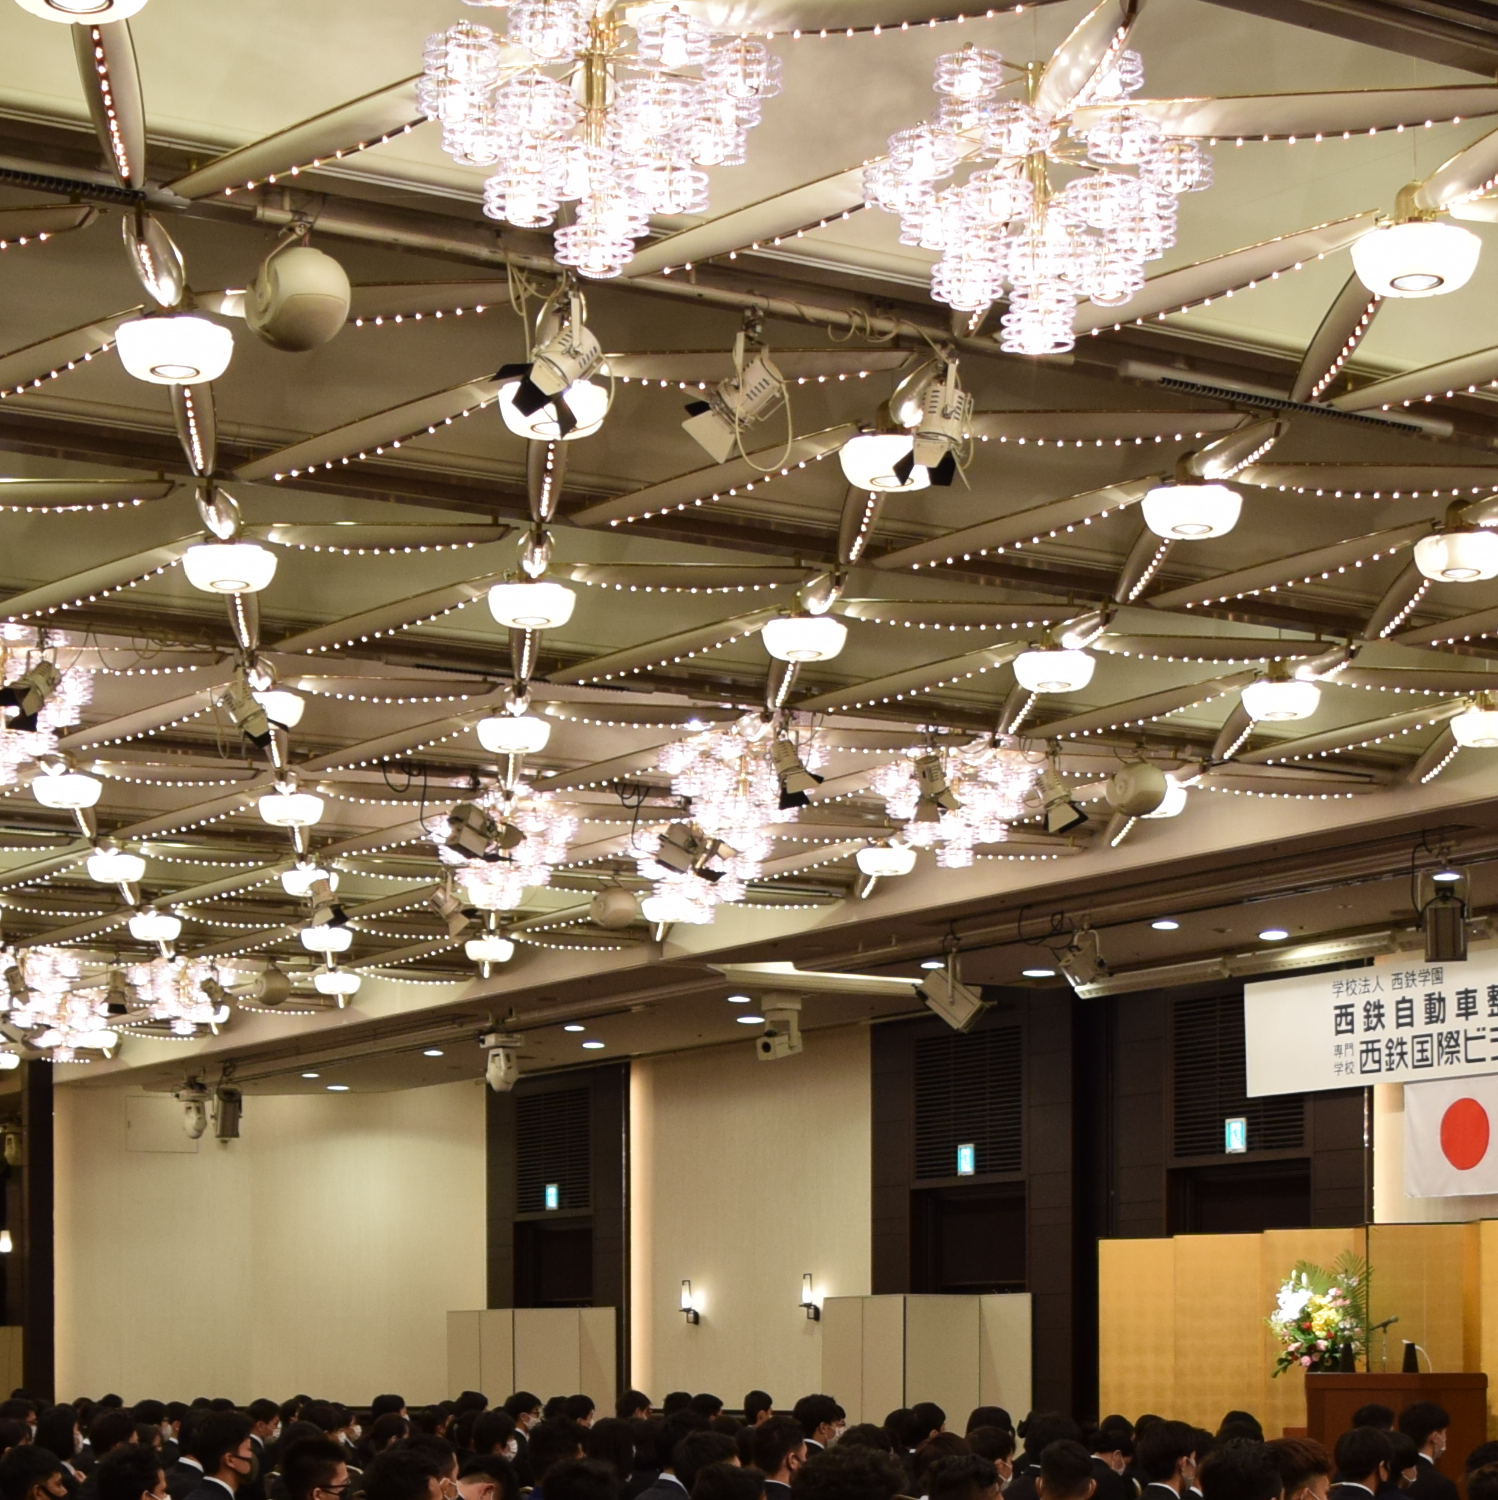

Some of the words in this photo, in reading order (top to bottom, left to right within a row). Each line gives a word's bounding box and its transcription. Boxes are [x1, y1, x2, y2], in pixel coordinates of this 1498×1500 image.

[1332, 975, 1385, 998] 学校法人
[1391, 966, 1444, 991] 西鉄学園
